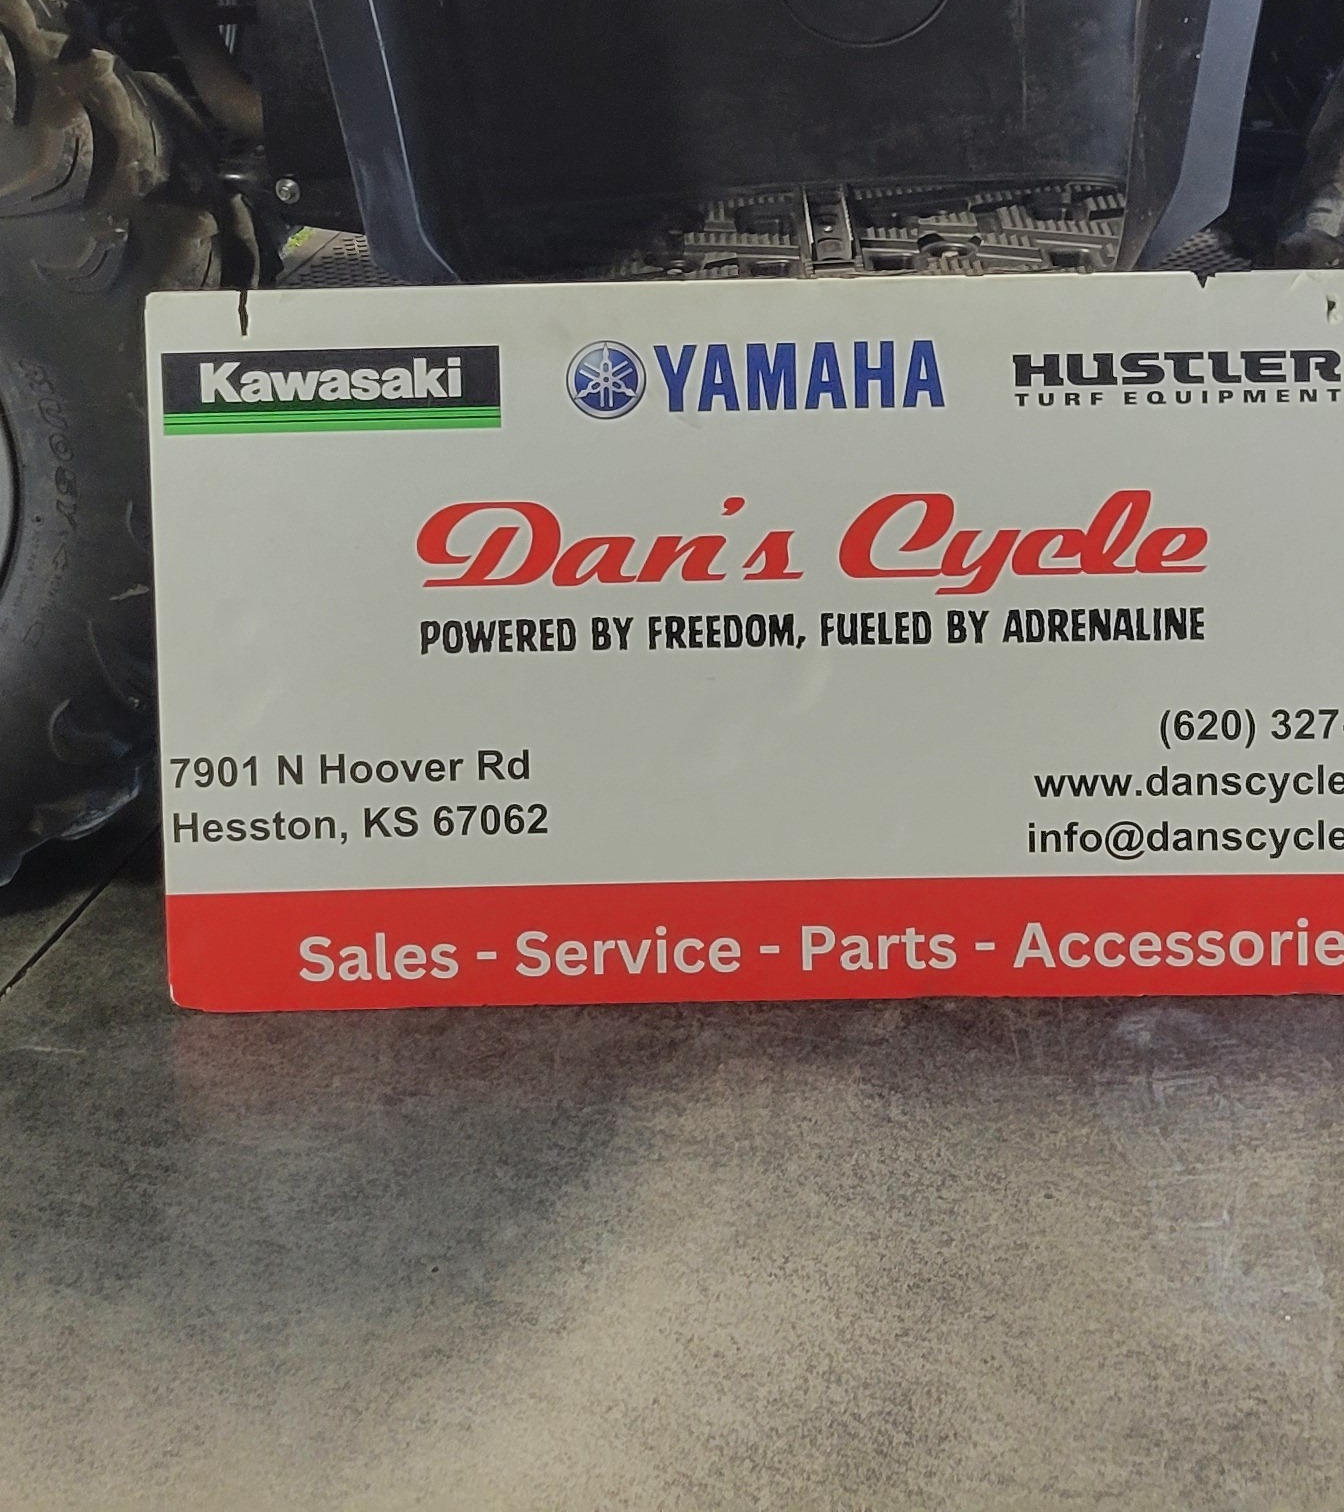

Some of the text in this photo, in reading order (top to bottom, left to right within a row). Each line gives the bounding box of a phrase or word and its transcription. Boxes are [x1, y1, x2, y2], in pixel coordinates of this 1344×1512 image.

[200, 357, 462, 403] Kawasaki
[656, 340, 943, 410] YAMAHA
[1012, 349, 1341, 387] HUSTLER
[1014, 388, 1342, 407] TURF EQUIPMENT
[416, 489, 1209, 595] Dan's Cycle
[420, 606, 1205, 656] POWERED BY FREEDOM, FUELED BY ADRENALINE
[1160, 708, 1256, 750] (620)
[170, 749, 530, 789] 7901 N Hoover Rd
[173, 803, 548, 845] Hesston, KS 67062
[299, 932, 459, 982] Sales
[515, 925, 741, 977] Service
[801, 925, 957, 971] Parts
